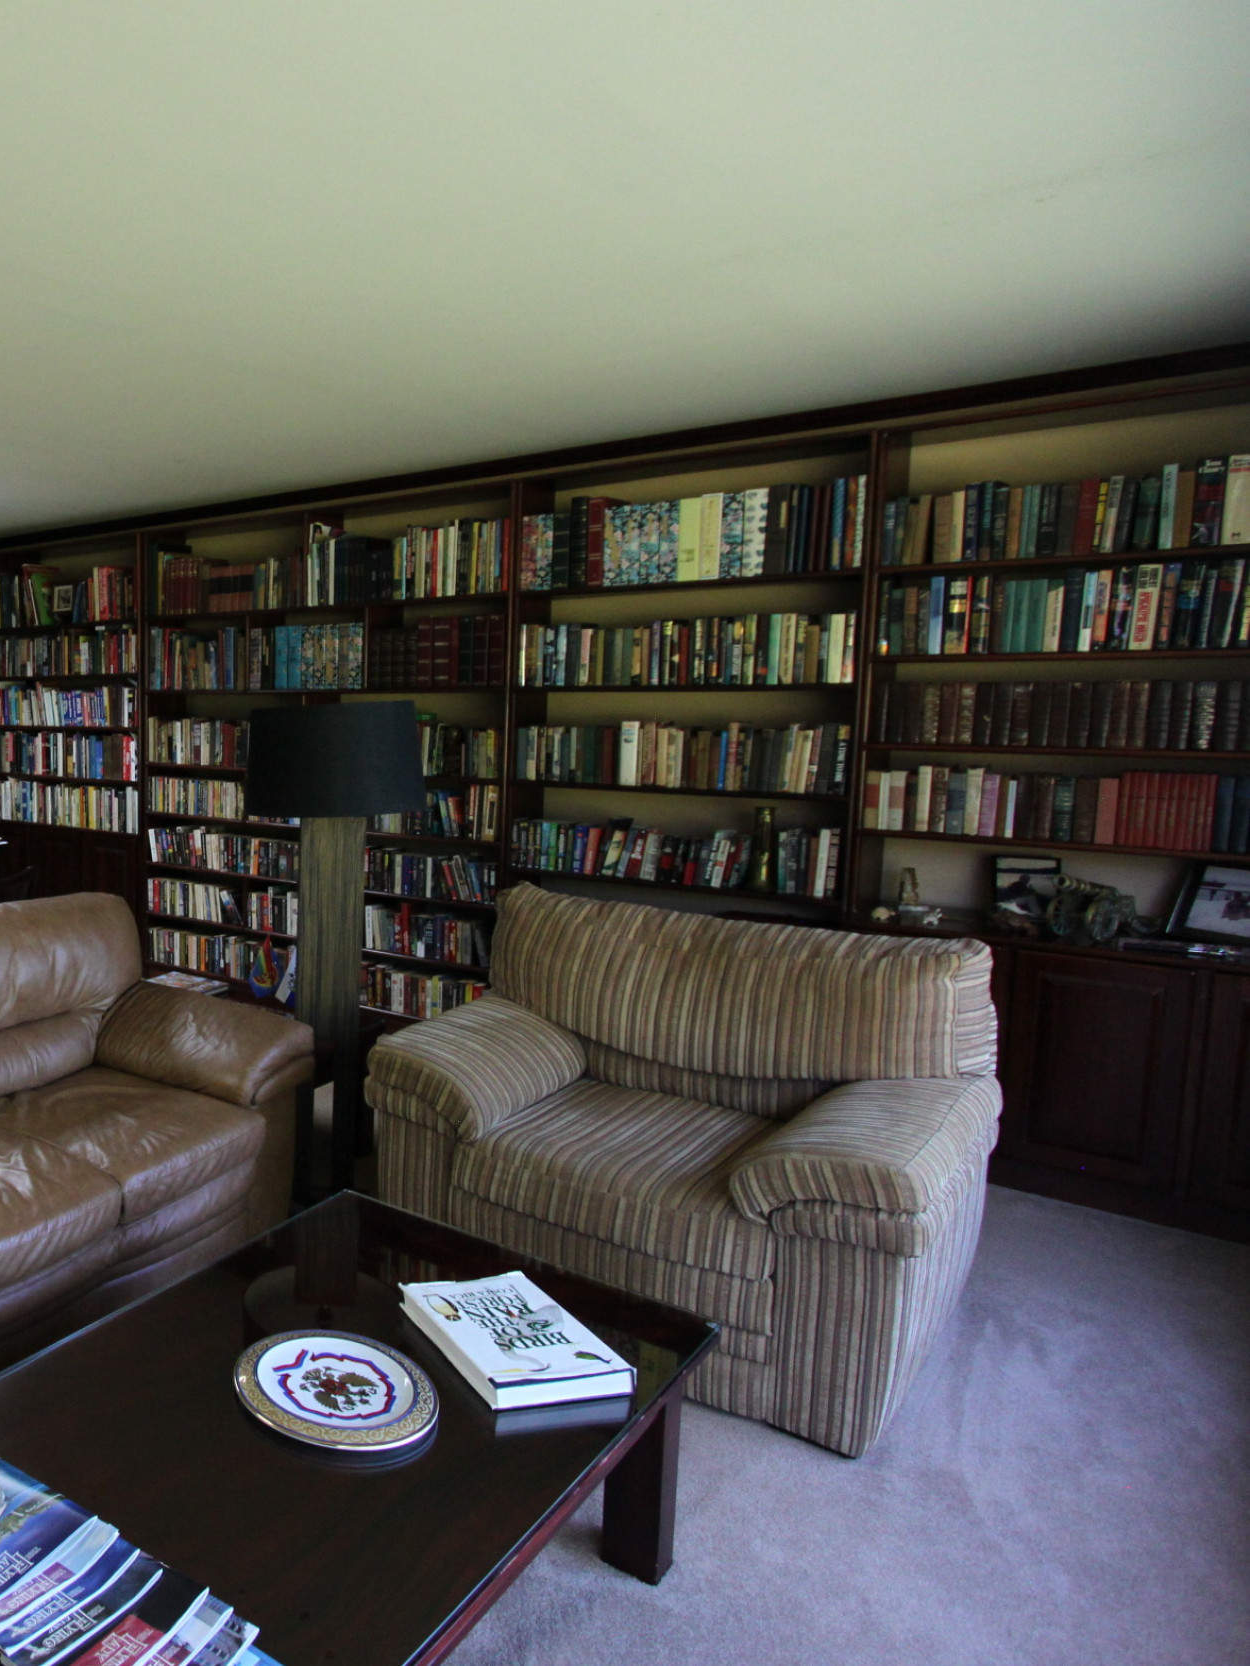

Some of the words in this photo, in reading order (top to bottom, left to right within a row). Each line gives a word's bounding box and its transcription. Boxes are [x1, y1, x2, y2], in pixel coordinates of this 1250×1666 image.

[449, 1291, 475, 1299] RICA
[476, 1287, 513, 1296] COSTA
[456, 1293, 524, 1310] FOREST
[462, 1302, 535, 1320] RAIN
[478, 1316, 519, 1328] THE
[490, 1326, 522, 1338] OF
[493, 1331, 573, 1351] BIRDS
[7, 1573, 59, 1610] FLYING
[23, 1590, 78, 1627] FLYING
[41, 1608, 98, 1650] FLYING
[94, 1631, 131, 1662] LADY
